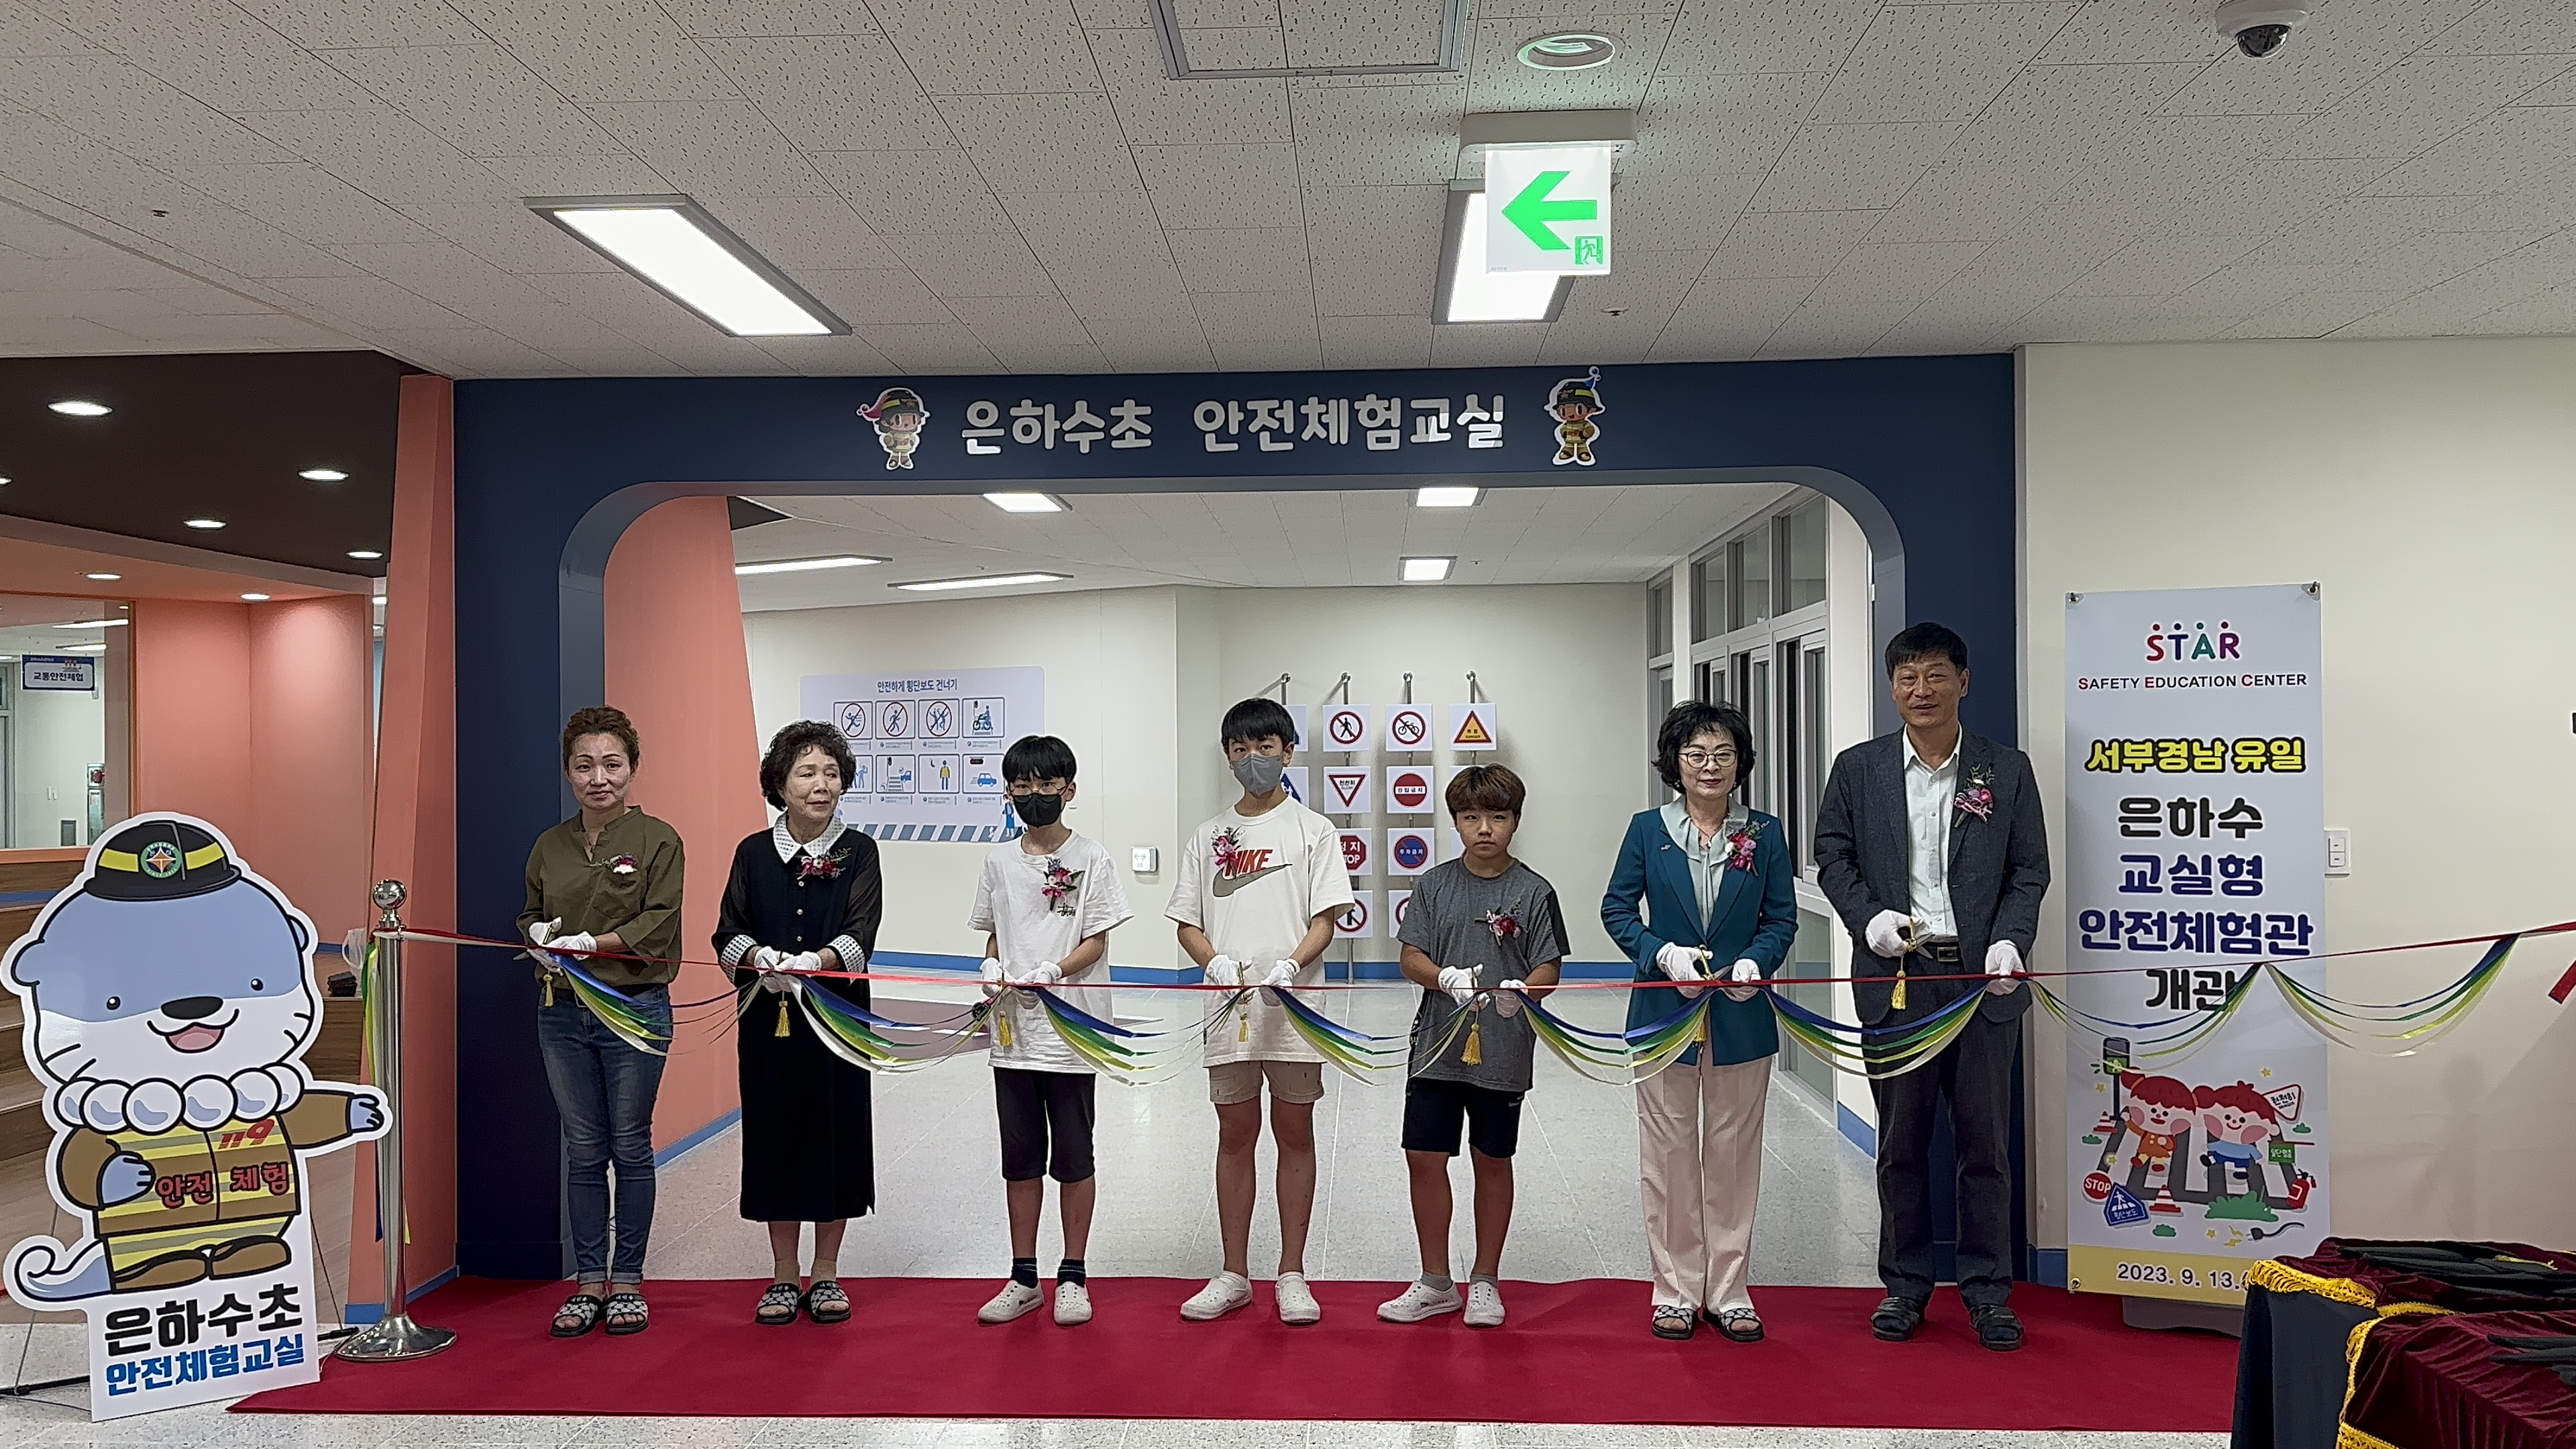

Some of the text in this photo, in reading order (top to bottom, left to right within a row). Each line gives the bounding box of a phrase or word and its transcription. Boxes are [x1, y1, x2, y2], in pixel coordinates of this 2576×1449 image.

[961, 394, 1505, 455] 은하수초 안전체험교실
[2147, 622, 2240, 661] STAR
[877, 678, 957, 693] 안전하게 횡단보도 건너기
[2078, 674, 2308, 690] SAFETY EDUCATION CENTER
[2085, 737, 2306, 773] 서부경남 유일
[2118, 797, 2263, 838] 은하수
[1225, 849, 1273, 876] NIKE
[1343, 854, 1360, 864] TOP
[2118, 855, 2263, 896] 교실형
[2079, 910, 2314, 955] 안전체험관
[2145, 969, 2238, 1012] 개관
[217, 1118, 275, 1149] 119
[156, 1161, 290, 1210] 안전 체험
[2084, 1177, 2112, 1193] STOP
[2118, 1263, 2174, 1284] 2023.
[2181, 1269, 2200, 1286] 9.
[105, 1283, 303, 1357] 은하수초
[106, 1333, 304, 1397] 안전체험교실
